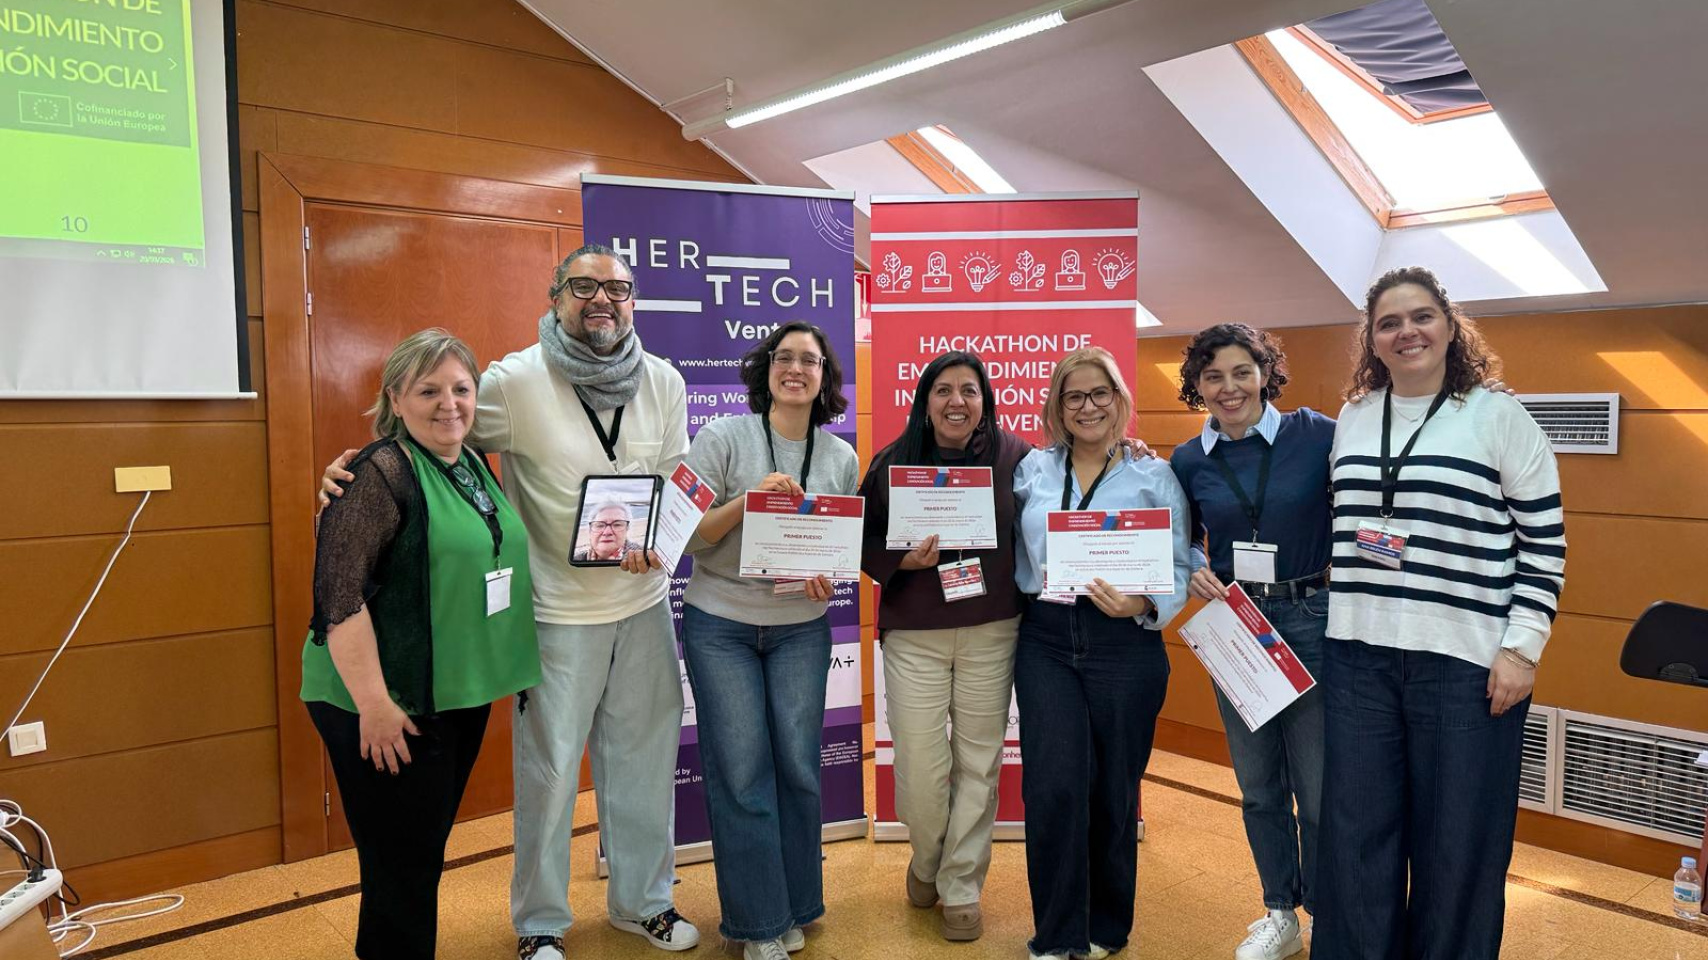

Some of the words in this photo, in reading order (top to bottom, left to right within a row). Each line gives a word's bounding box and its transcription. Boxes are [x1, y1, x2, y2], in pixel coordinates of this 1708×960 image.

[62, 58, 168, 93] SOCIAL
[76, 102, 146, 119] Cofinanciado
[77, 113, 87, 122] la
[90, 114, 121, 126] Unión
[123, 120, 166, 132] Europea
[62, 215, 88, 232] 10
[612, 238, 700, 269] HER
[706, 274, 833, 308] TECH
[725, 320, 778, 340] Vent
[920, 334, 1058, 353] HACKATHON
[1064, 334, 1092, 352] DE
[834, 587, 853, 595] tech
